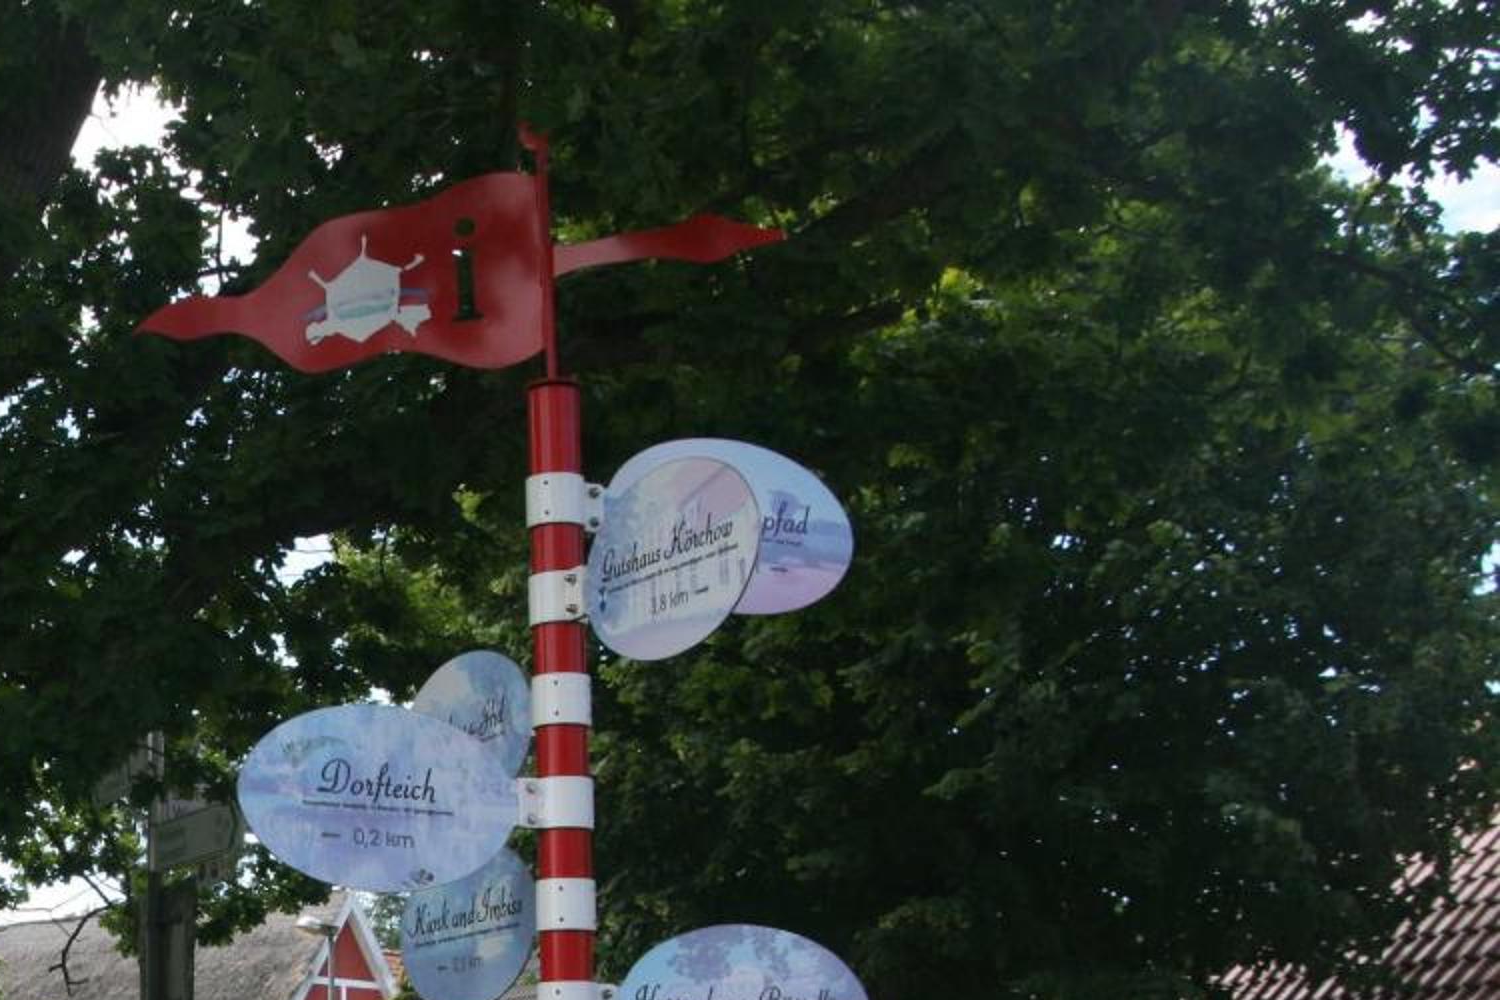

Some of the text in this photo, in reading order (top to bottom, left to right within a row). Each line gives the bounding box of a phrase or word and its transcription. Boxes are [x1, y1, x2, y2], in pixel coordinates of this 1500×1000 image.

[762, 500, 810, 535] pfad
[601, 541, 661, 583] Gutshaus
[663, 511, 733, 559] Körchow
[668, 591, 689, 608] km
[316, 758, 436, 803] Dorfteich
[353, 828, 415, 848] 0,2 km
